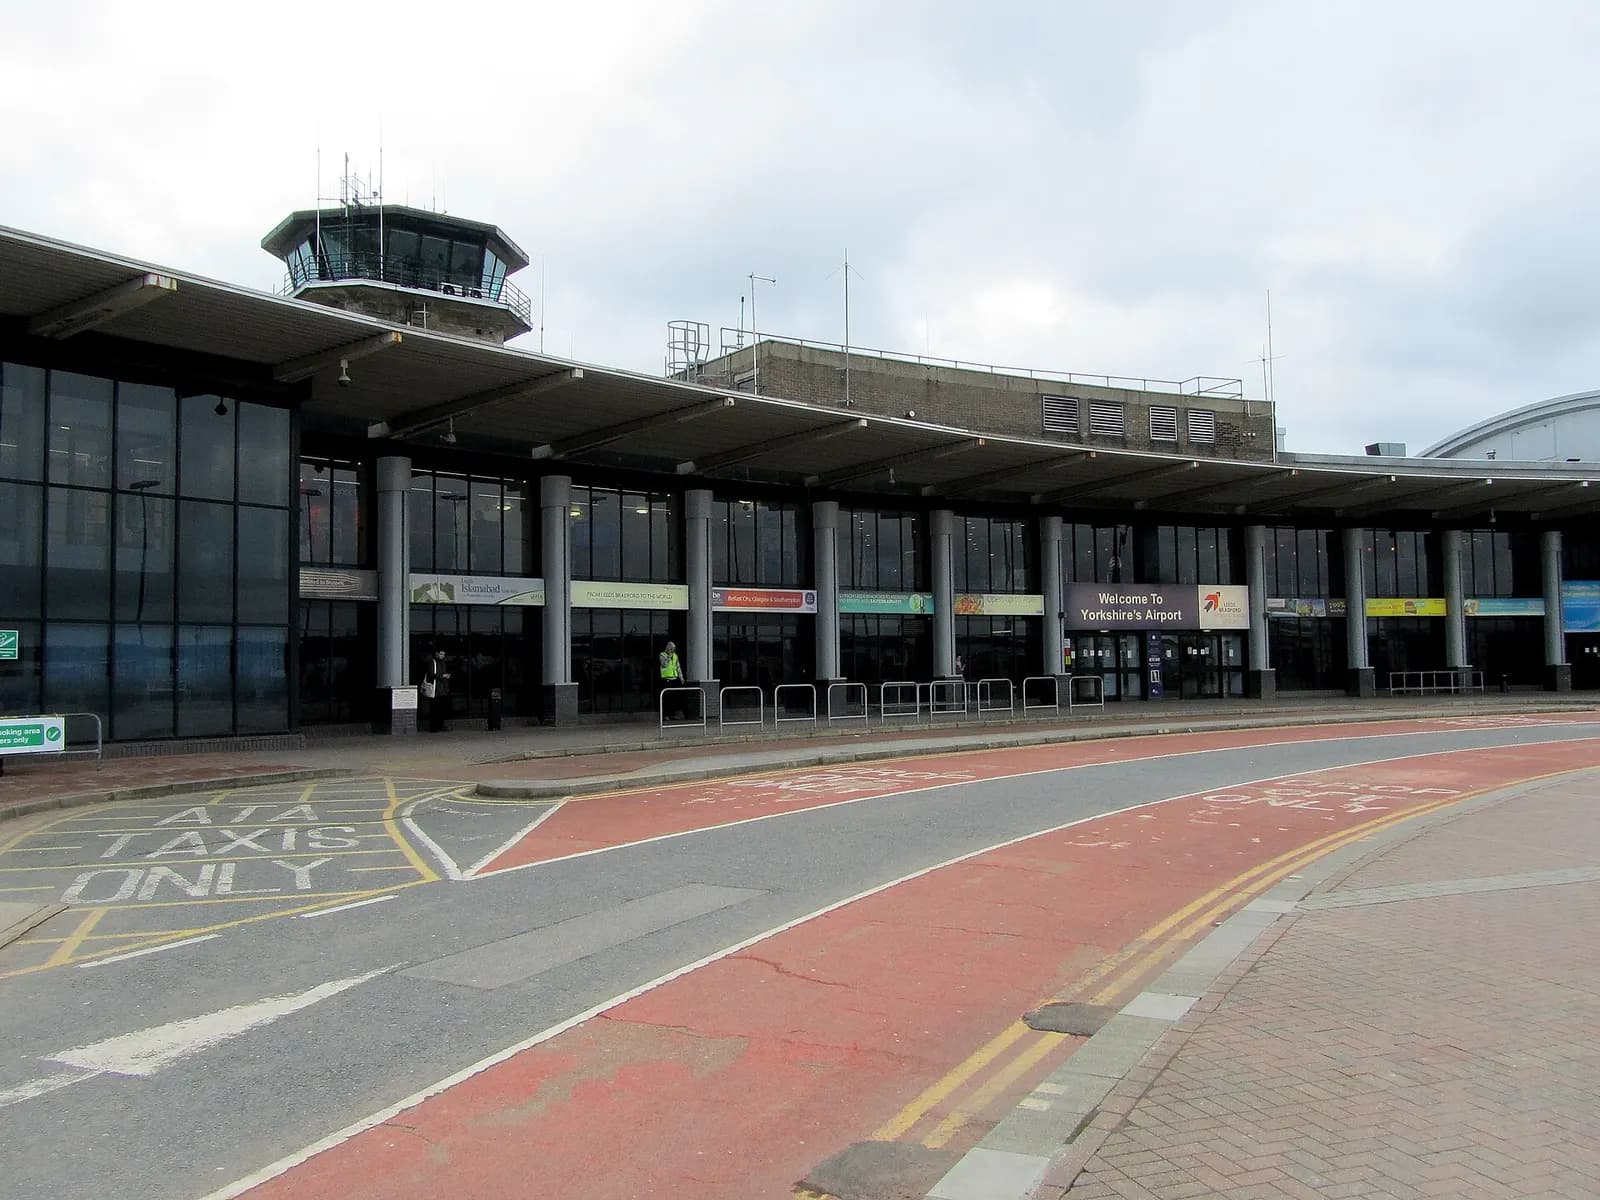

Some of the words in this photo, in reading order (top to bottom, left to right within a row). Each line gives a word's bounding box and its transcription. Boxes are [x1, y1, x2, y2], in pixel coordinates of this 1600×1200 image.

[461, 583, 500, 593] Islamabad
[1098, 592, 1148, 605] Welcome
[1150, 592, 1164, 605] To
[1080, 609, 1142, 621] Yorkshire's
[1145, 609, 1183, 623] Airport
[153, 804, 319, 826] ATA
[98, 827, 361, 859] TAXIS
[60, 858, 334, 904] ONLY
